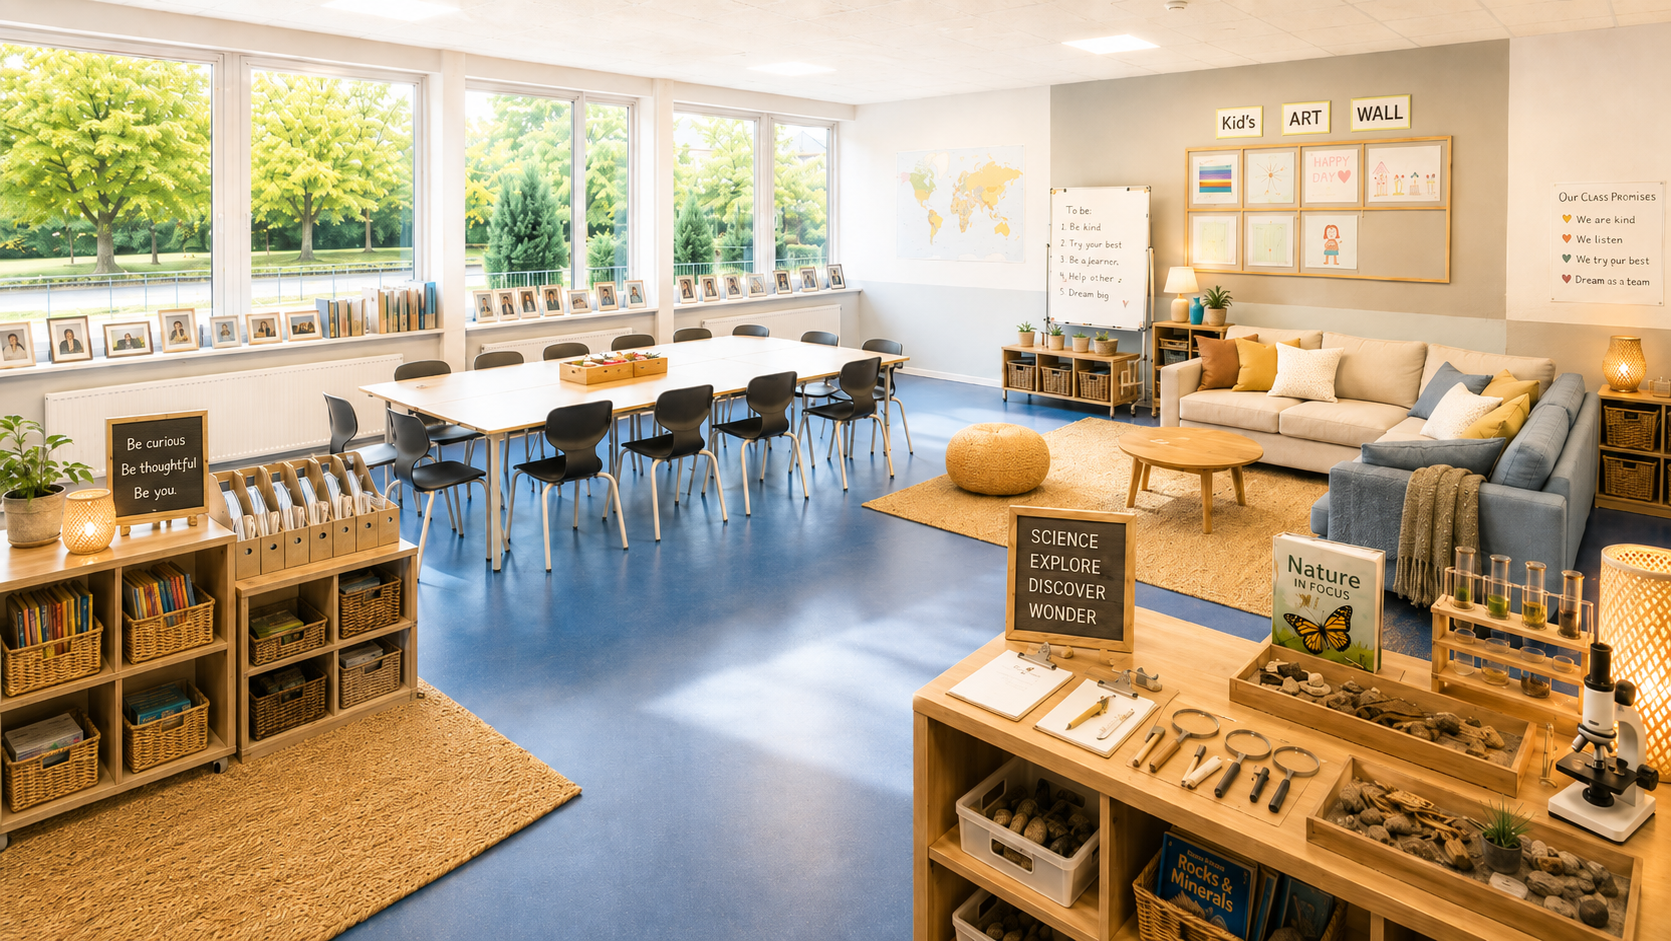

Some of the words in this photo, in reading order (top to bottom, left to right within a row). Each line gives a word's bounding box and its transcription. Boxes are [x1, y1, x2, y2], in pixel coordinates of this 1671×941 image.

[1289, 110, 1322, 127] ART
[1357, 104, 1404, 122] WALL
[1222, 114, 1256, 131] Kid's
[1313, 155, 1350, 167] HAPPY
[1312, 171, 1336, 183] DAY
[1558, 191, 1578, 202] Our
[1066, 205, 1078, 215] To
[1079, 206, 1092, 215] be:
[1061, 223, 1067, 231] 1.
[1069, 222, 1080, 231] Be
[1083, 222, 1102, 231] kind
[1576, 215, 1592, 224] We
[1594, 216, 1611, 224] are
[1614, 215, 1636, 224] kind
[1069, 239, 1083, 250] Try
[1085, 242, 1103, 250] your
[1105, 240, 1122, 249] best
[1576, 235, 1592, 244] We
[1594, 234, 1623, 244] listen
[1069, 255, 1079, 264] Be
[1576, 254, 1591, 264] We
[1593, 256, 1608, 268] try
[1628, 256, 1650, 266] best
[1069, 272, 1087, 284] Help
[1575, 275, 1605, 285] Dream
[1607, 278, 1618, 286] as
[1626, 277, 1650, 287] team
[1068, 288, 1095, 298] Dream
[1097, 290, 1110, 302] big
[127, 437, 142, 451] Be
[146, 436, 186, 449] curious
[121, 463, 136, 476] Be
[139, 457, 197, 476] thoughtful
[134, 486, 150, 500] Be
[154, 487, 177, 501] you.
[1031, 528, 1099, 549] SCIENCE
[1030, 553, 1101, 575] EXPLORE
[1288, 554, 1361, 589] Nature
[1028, 577, 1106, 600] DISCOVER
[1294, 578, 1306, 589] IN
[1309, 582, 1350, 601] FOCUS
[1029, 602, 1097, 625] WONDER
[1177, 853, 1219, 887] Rocks
[1221, 877, 1233, 895] &
[1171, 867, 1234, 913] Minerals
